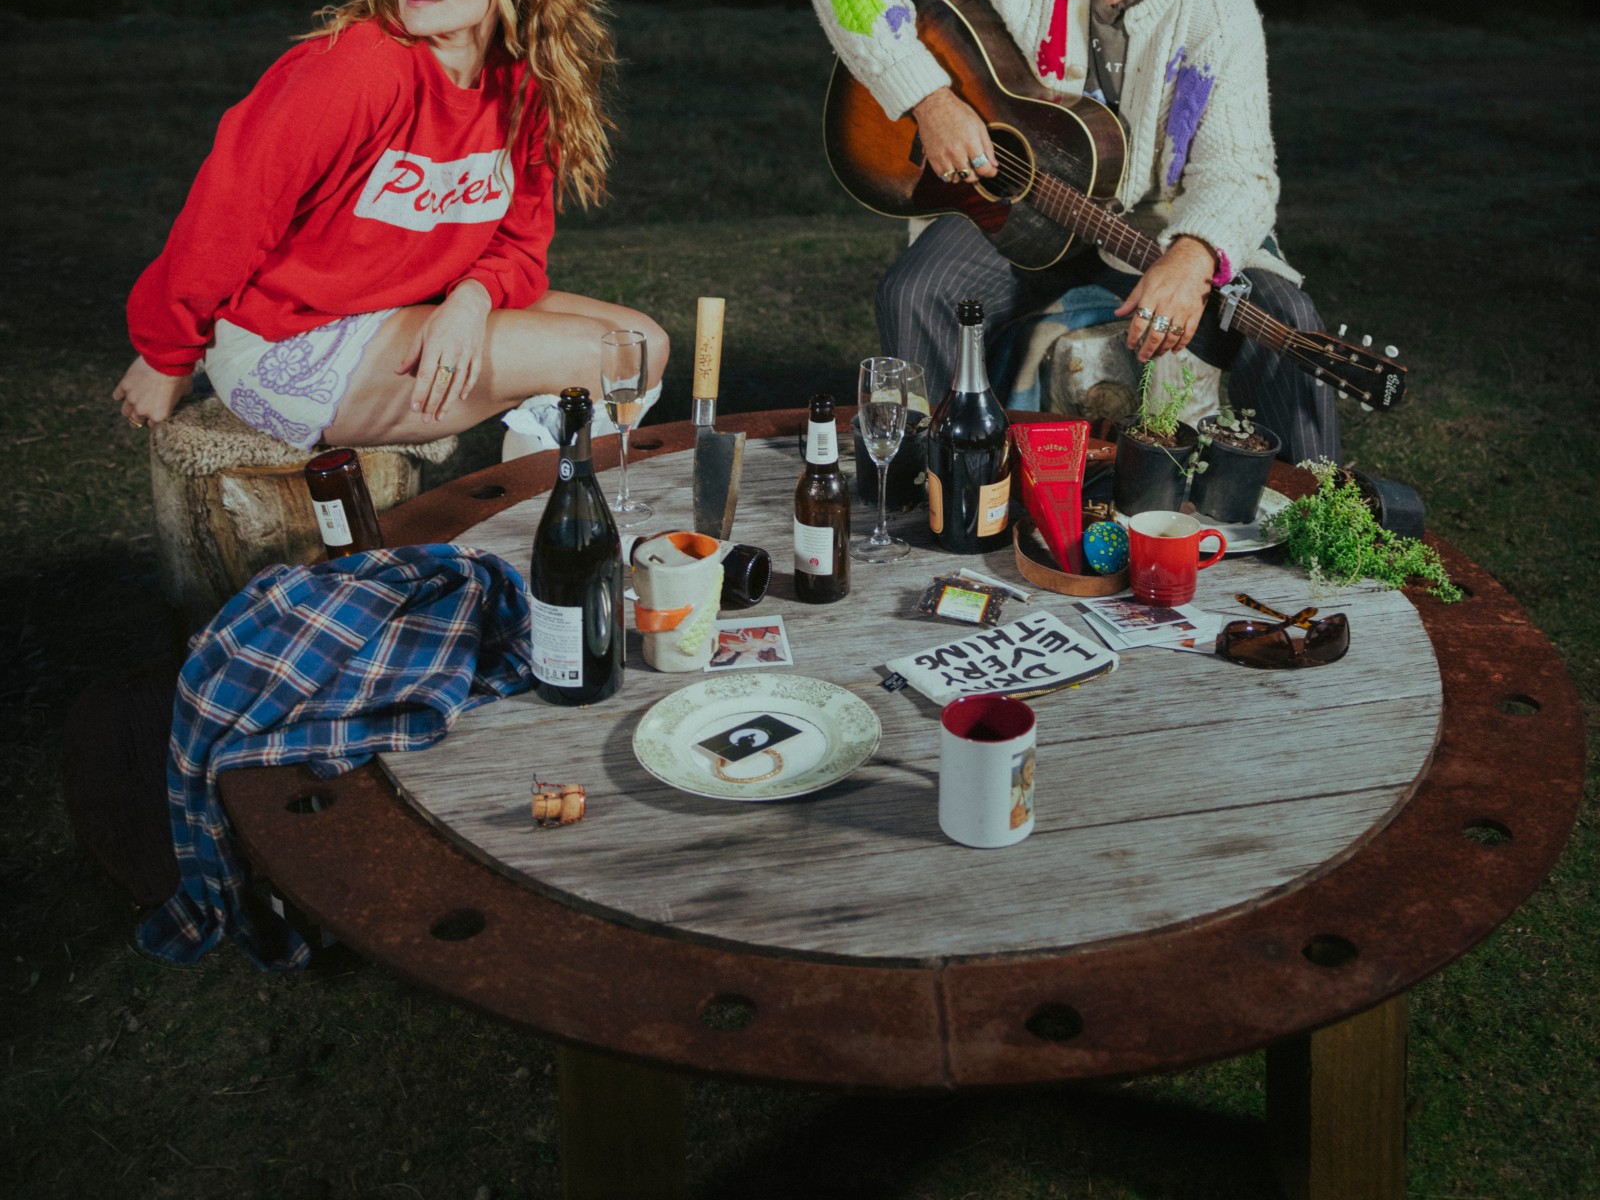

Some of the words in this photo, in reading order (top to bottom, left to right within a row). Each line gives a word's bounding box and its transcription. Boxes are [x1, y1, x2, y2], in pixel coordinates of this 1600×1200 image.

[1383, 374, 1400, 405] Gibson
[561, 462, 571, 477] G
[941, 630, 1070, 686] EVERY
[1062, 643, 1098, 661] I
